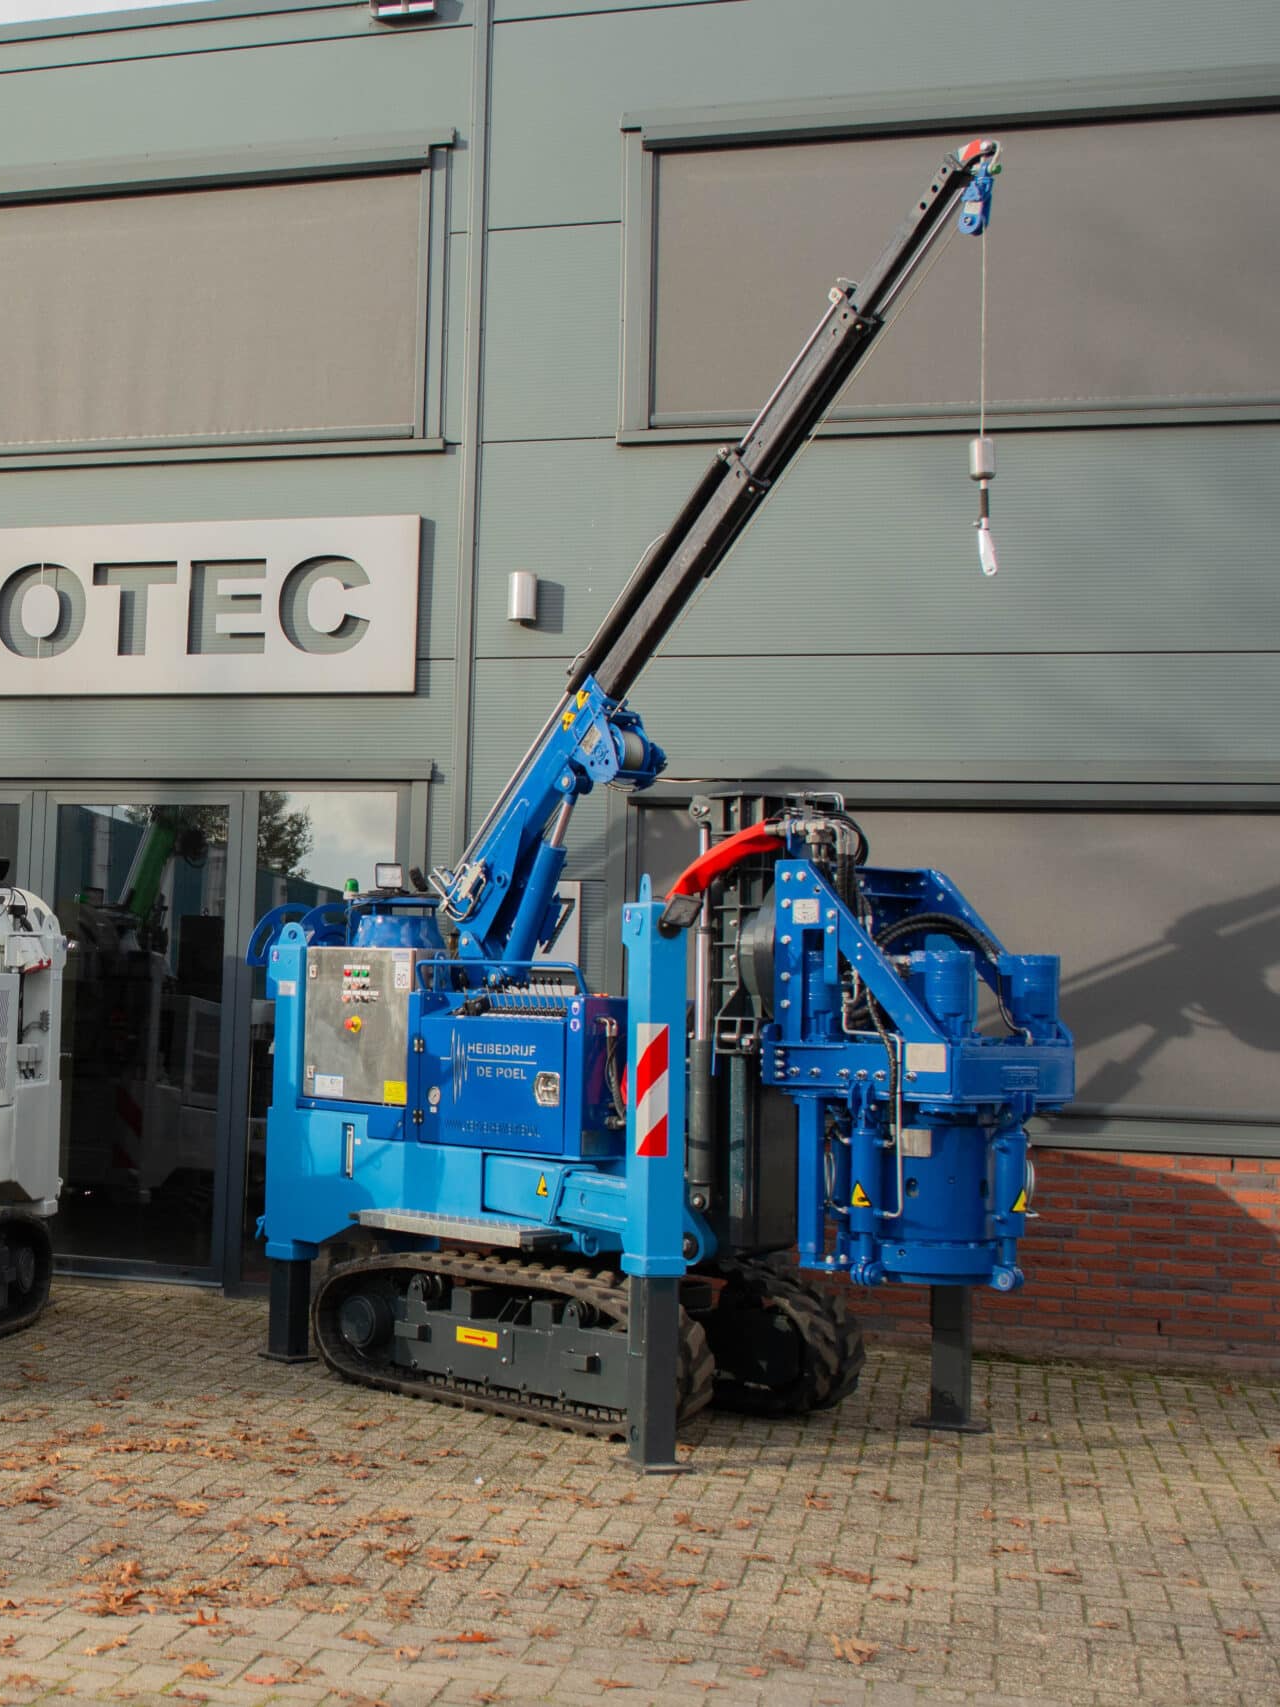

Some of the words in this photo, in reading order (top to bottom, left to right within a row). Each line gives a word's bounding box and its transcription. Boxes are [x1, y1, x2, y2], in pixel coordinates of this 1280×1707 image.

[467, 1042, 537, 1057] HEIBEDRIJF
[476, 1066, 493, 1078] DE
[496, 1067, 527, 1080] POEL
